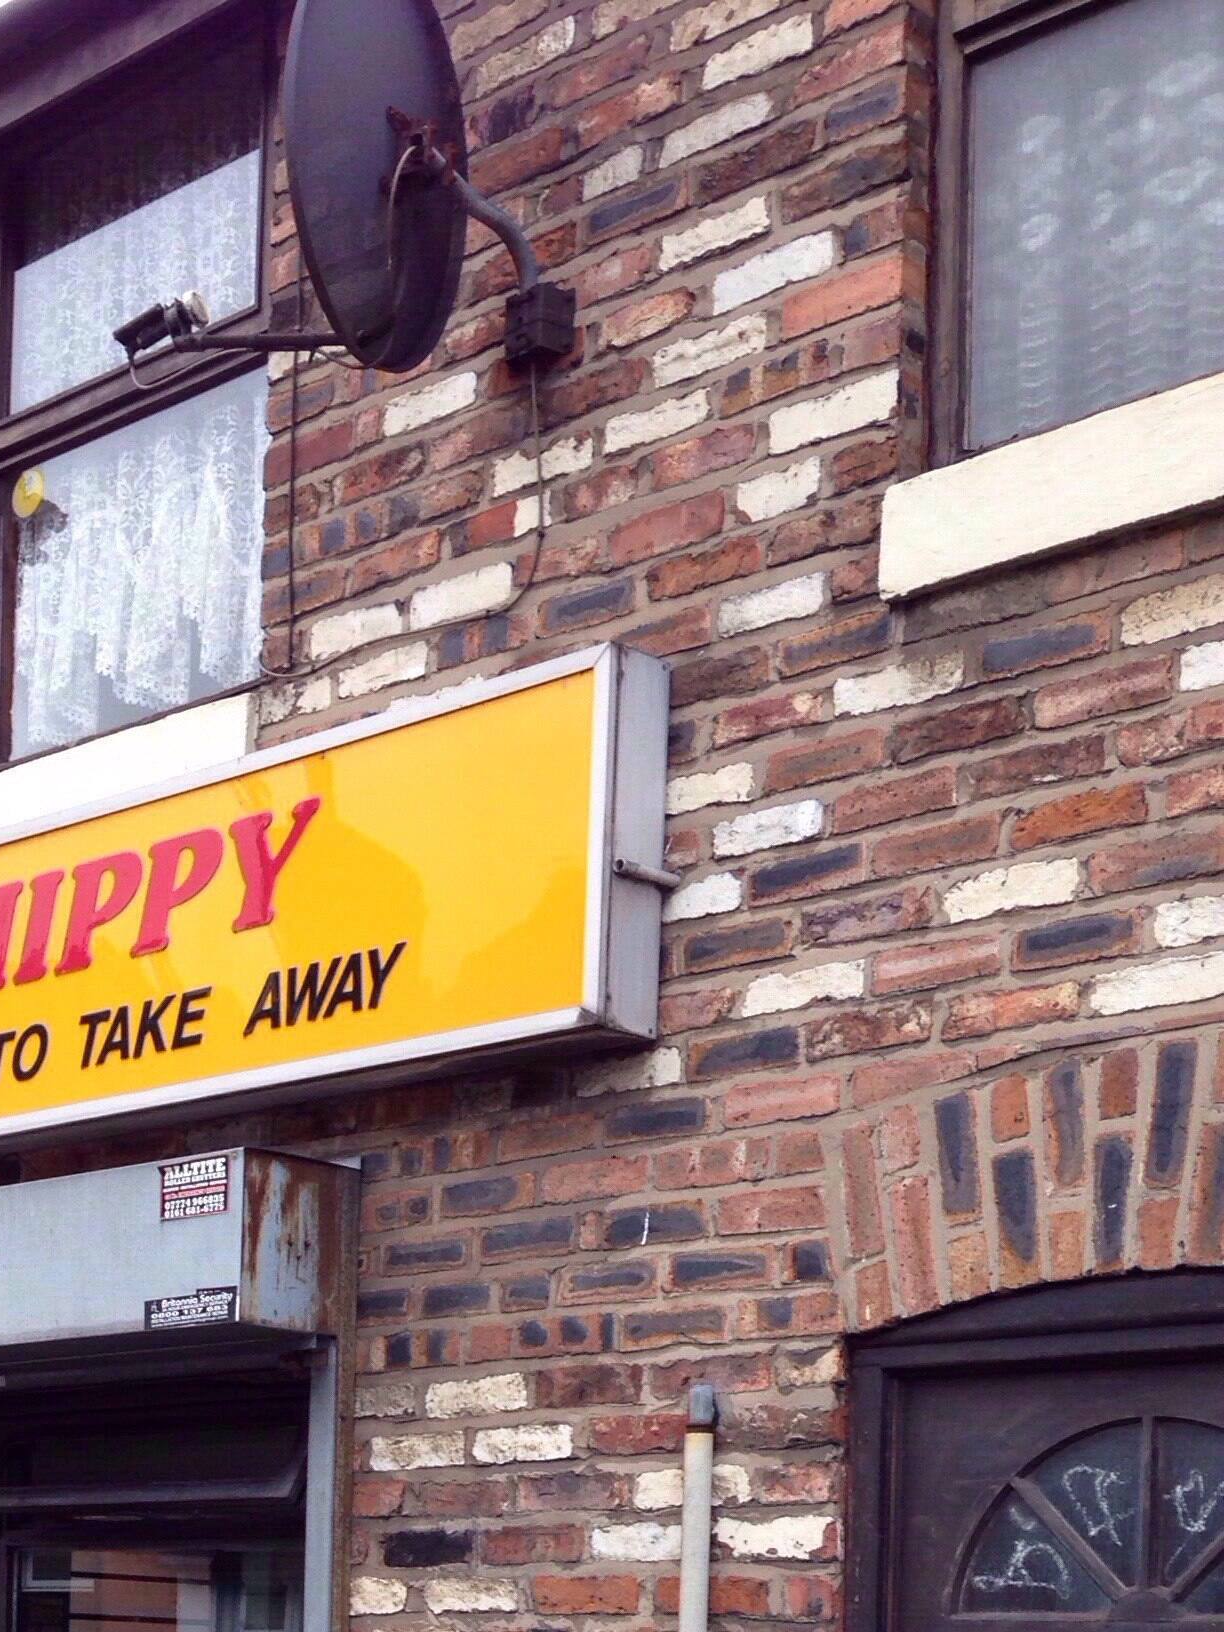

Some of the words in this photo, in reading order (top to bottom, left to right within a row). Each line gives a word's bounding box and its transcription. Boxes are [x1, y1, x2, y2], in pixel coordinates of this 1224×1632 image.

[79, 987, 213, 1069] TAKE
[243, 942, 407, 1037] AWAY
[163, 1157, 226, 1181] ALLTITE
[161, 1295, 198, 1309] Britannia
[199, 1291, 233, 1304] Security
